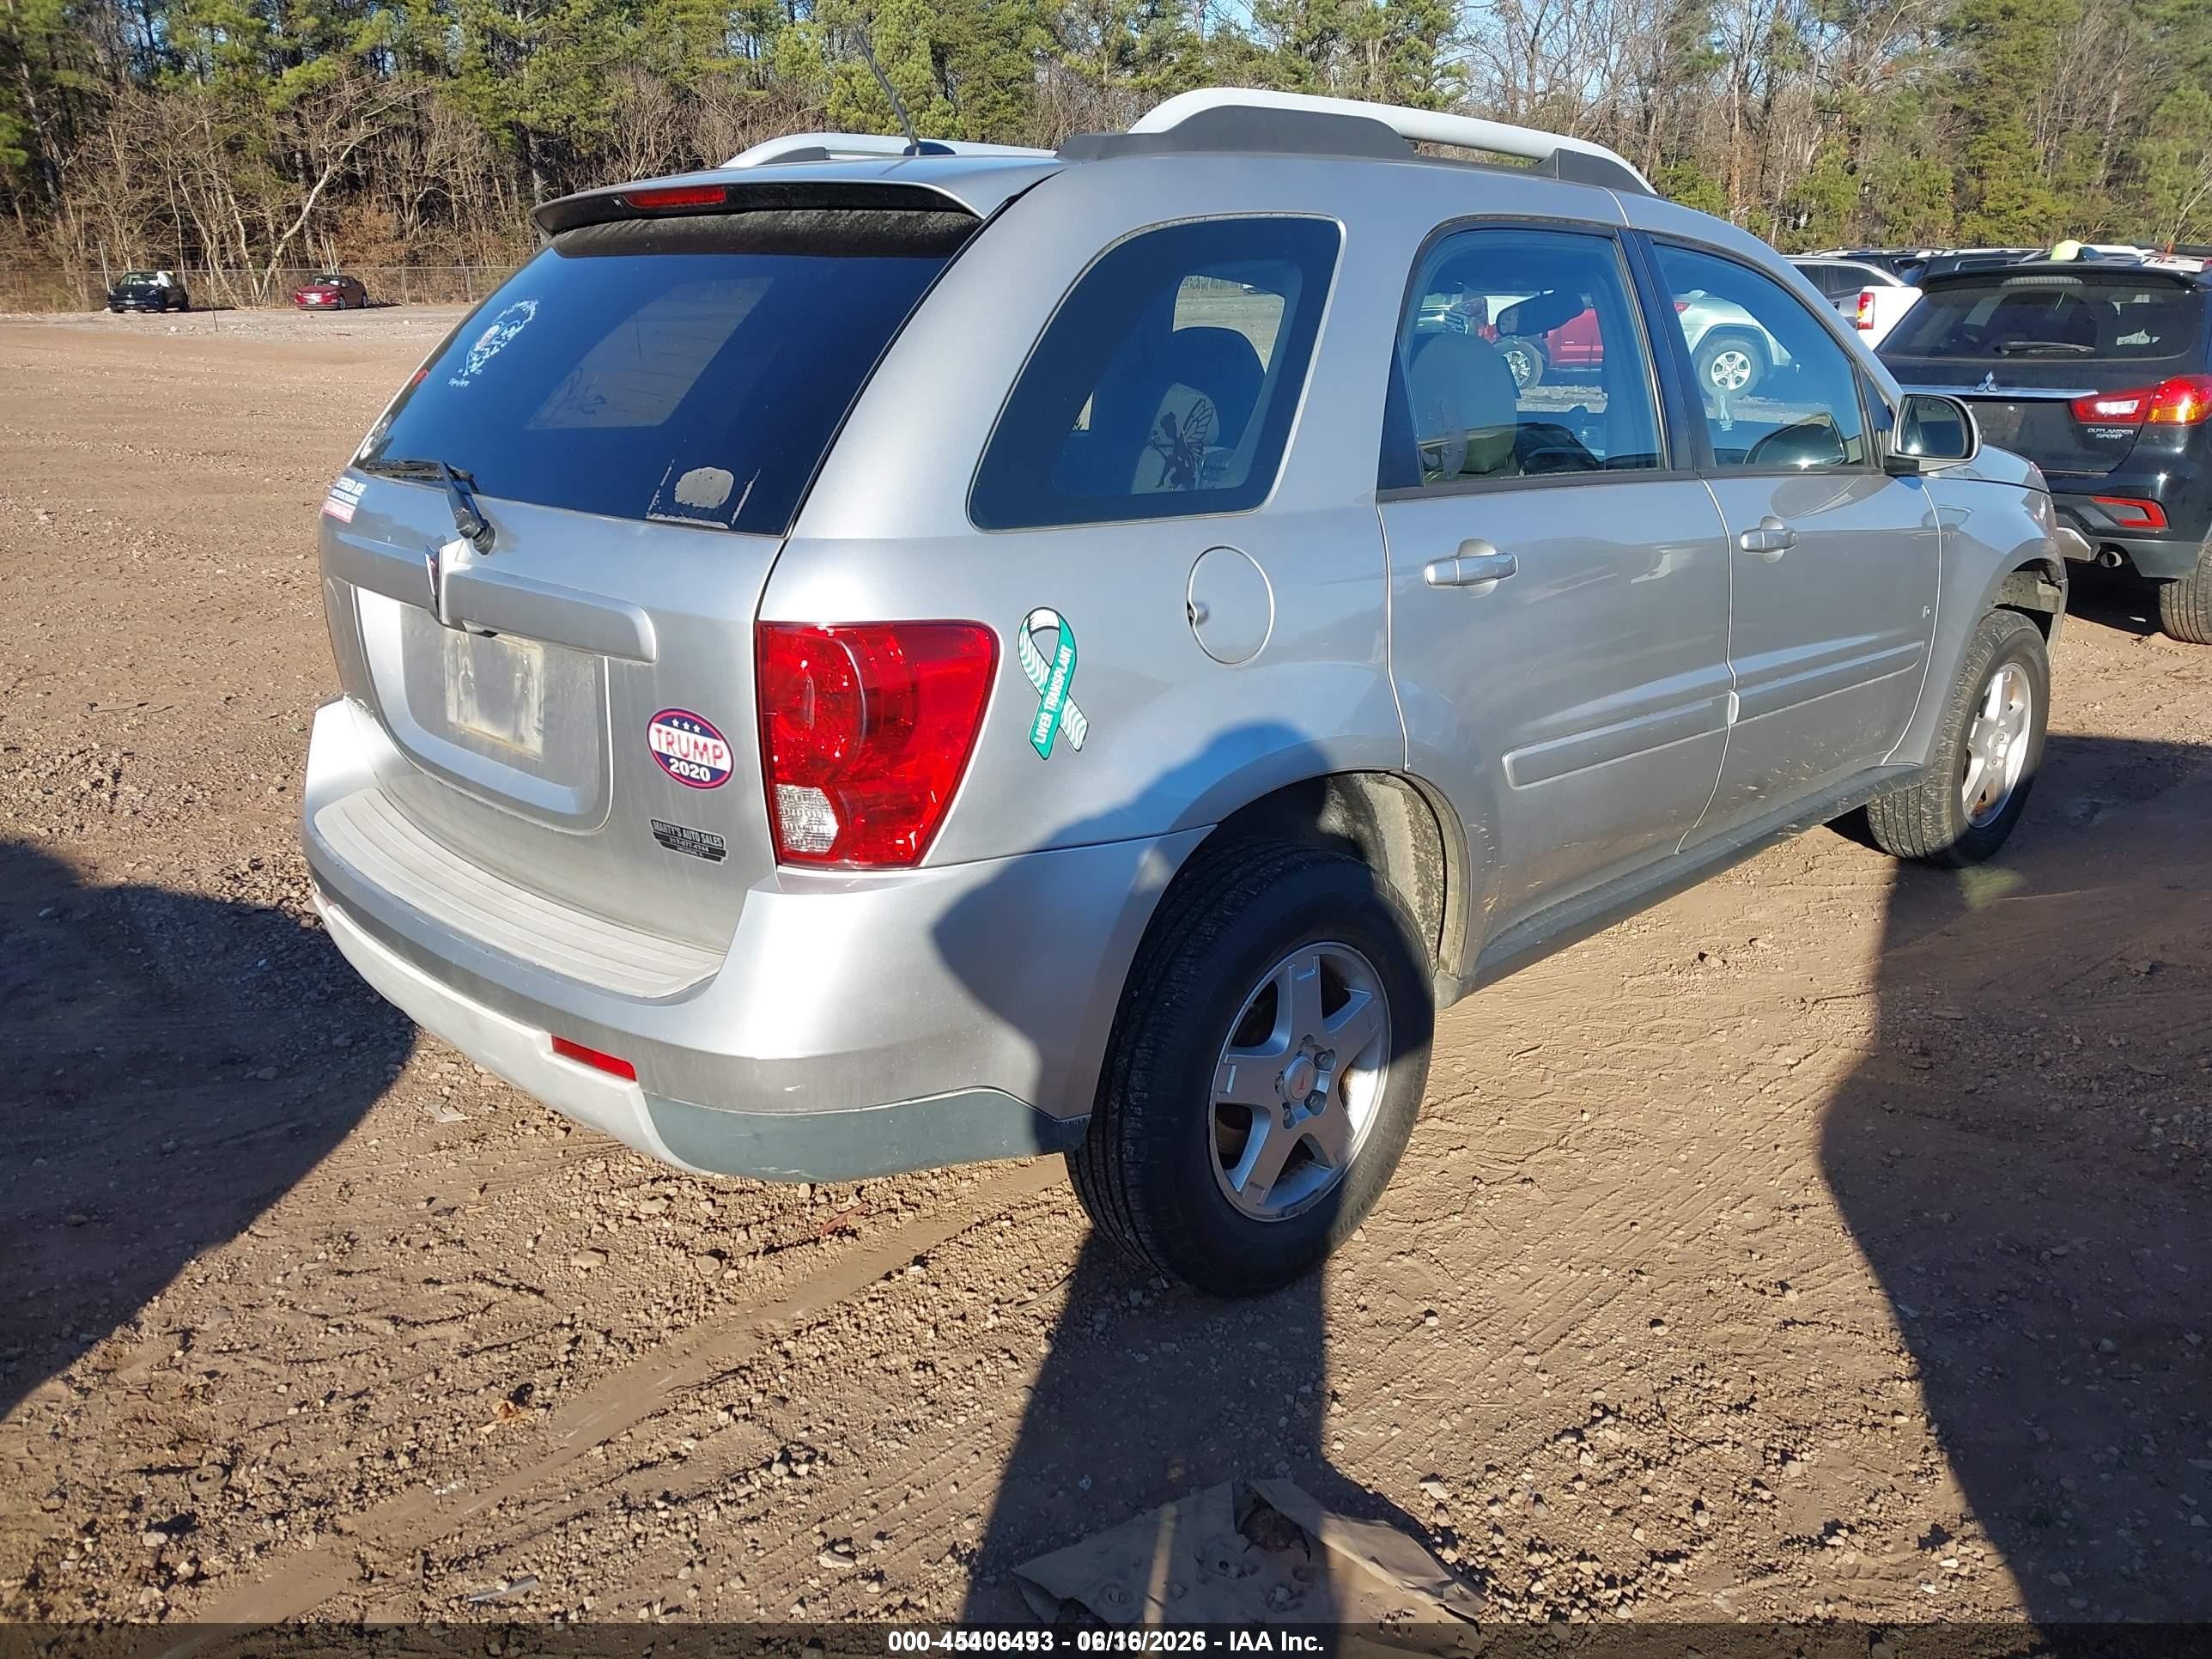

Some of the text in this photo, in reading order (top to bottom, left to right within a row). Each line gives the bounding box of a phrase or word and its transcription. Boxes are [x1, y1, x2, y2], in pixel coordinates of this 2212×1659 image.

[1035, 644, 1073, 744] LIVER TRANSPLANT
[654, 726, 723, 766] TRUMP
[668, 758, 711, 782] 2020
[683, 829, 701, 842] AUTO
[701, 833, 723, 848] SALES
